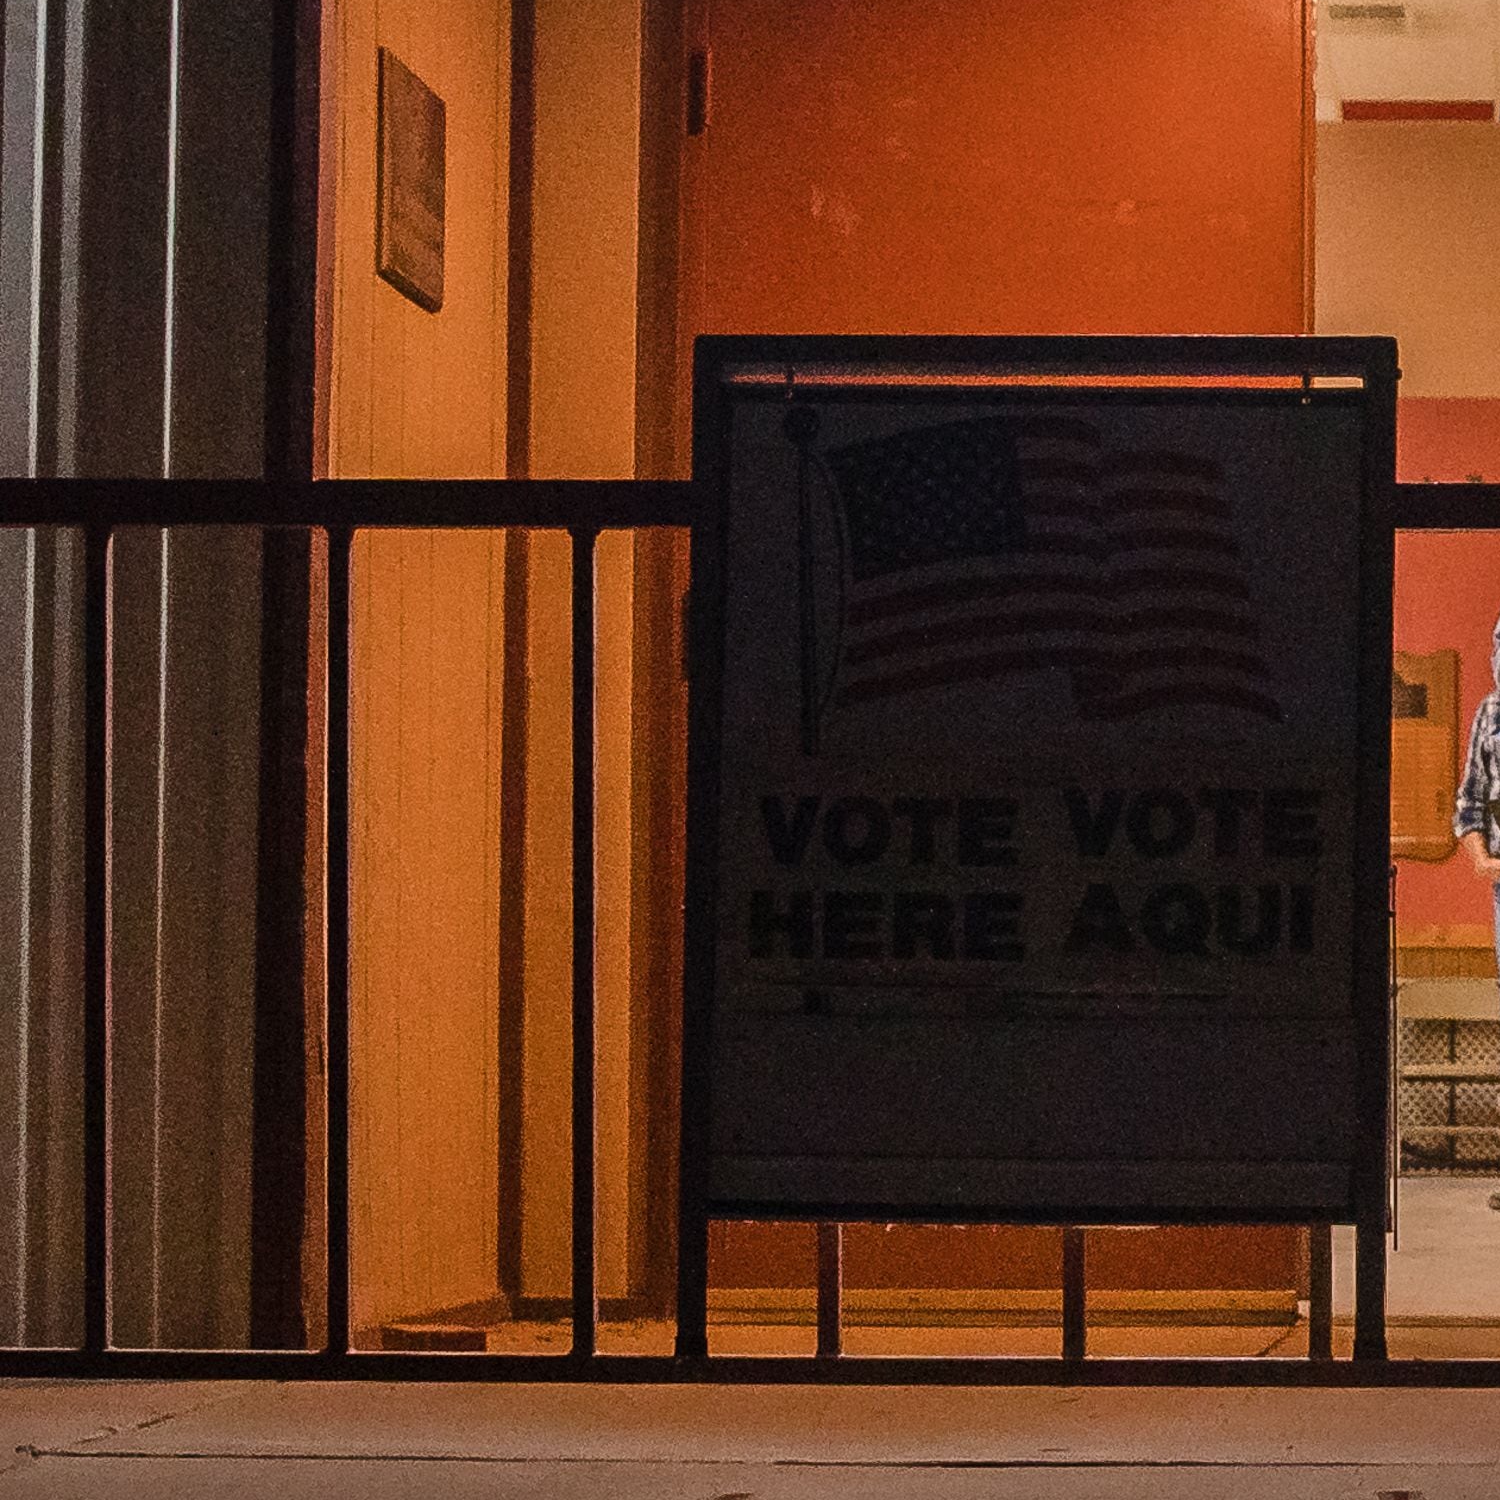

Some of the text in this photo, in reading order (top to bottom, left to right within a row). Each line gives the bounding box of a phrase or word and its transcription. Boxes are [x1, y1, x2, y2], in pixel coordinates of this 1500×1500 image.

[760, 796, 1018, 866] VOTE
[1063, 787, 1322, 858] VOTE
[748, 892, 1026, 961] HERE
[1063, 884, 1314, 956] AQUI
